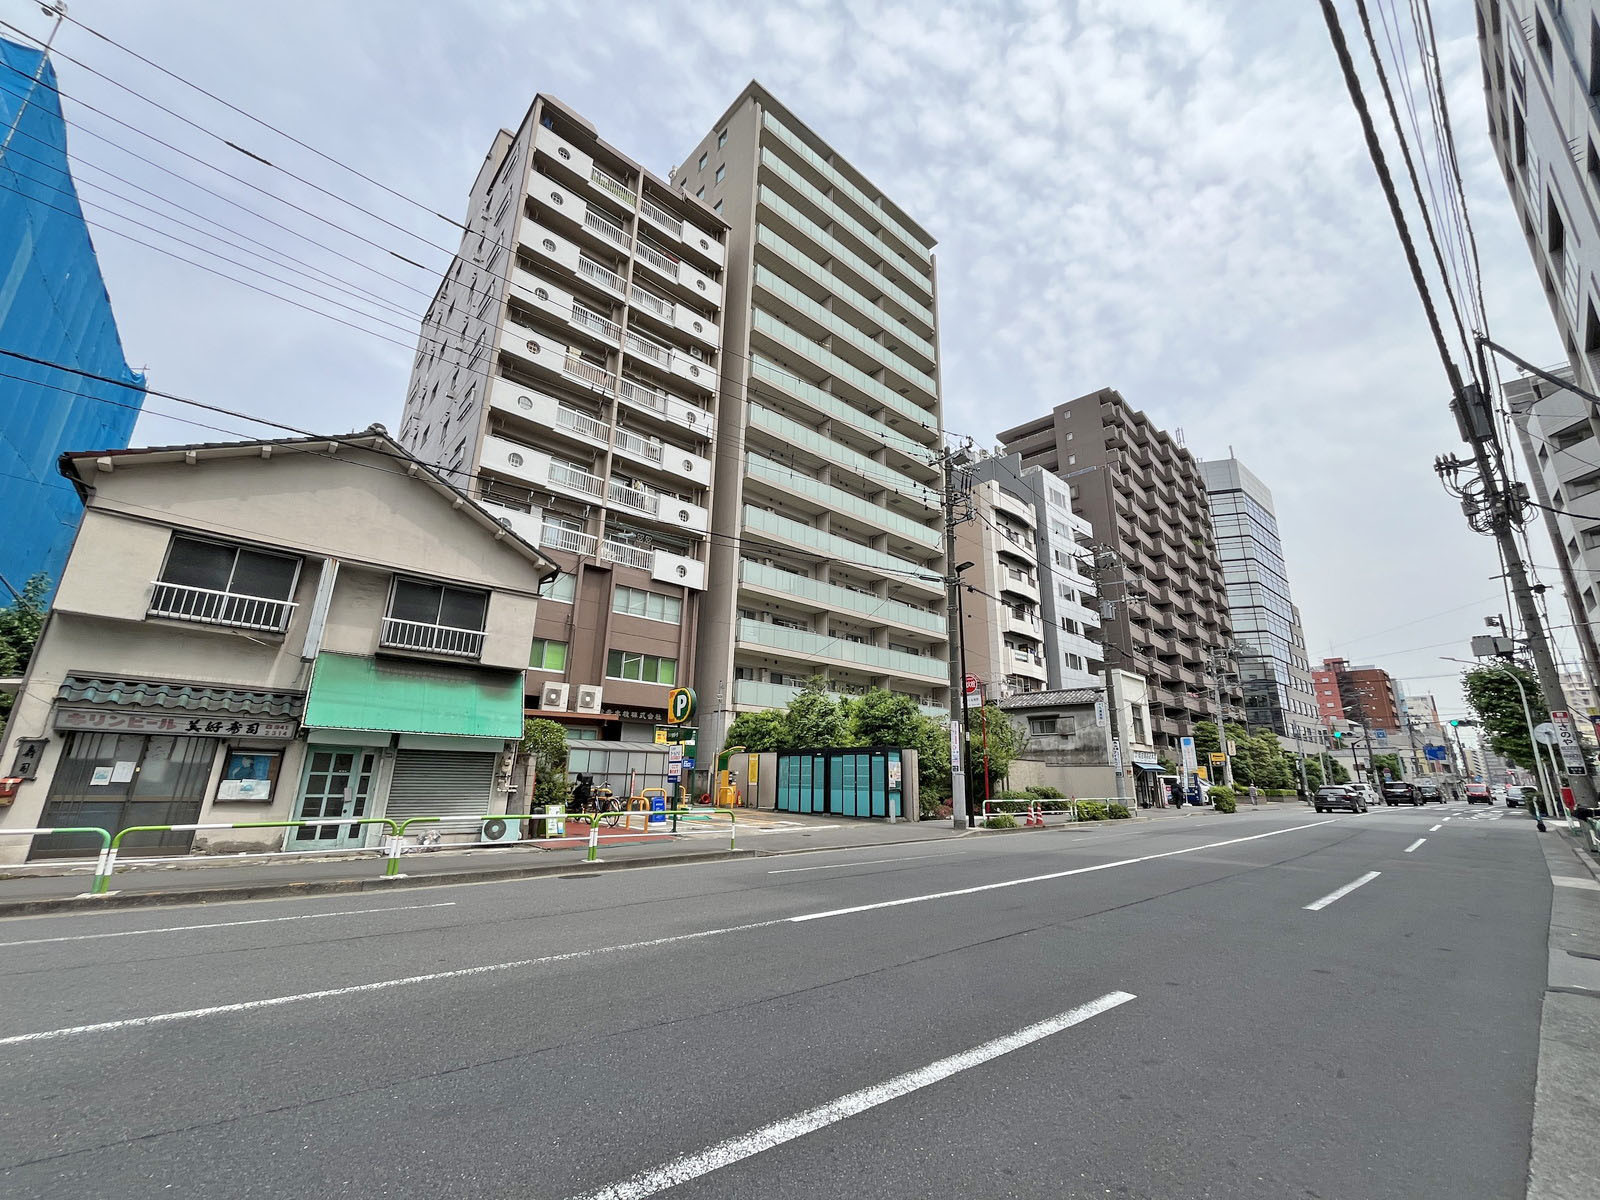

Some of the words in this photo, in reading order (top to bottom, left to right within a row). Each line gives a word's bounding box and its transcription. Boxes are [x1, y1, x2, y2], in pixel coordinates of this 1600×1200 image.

[677, 694, 687, 717] P
[66, 713, 177, 730] キリンビール
[1559, 721, 1573, 745] さのや
